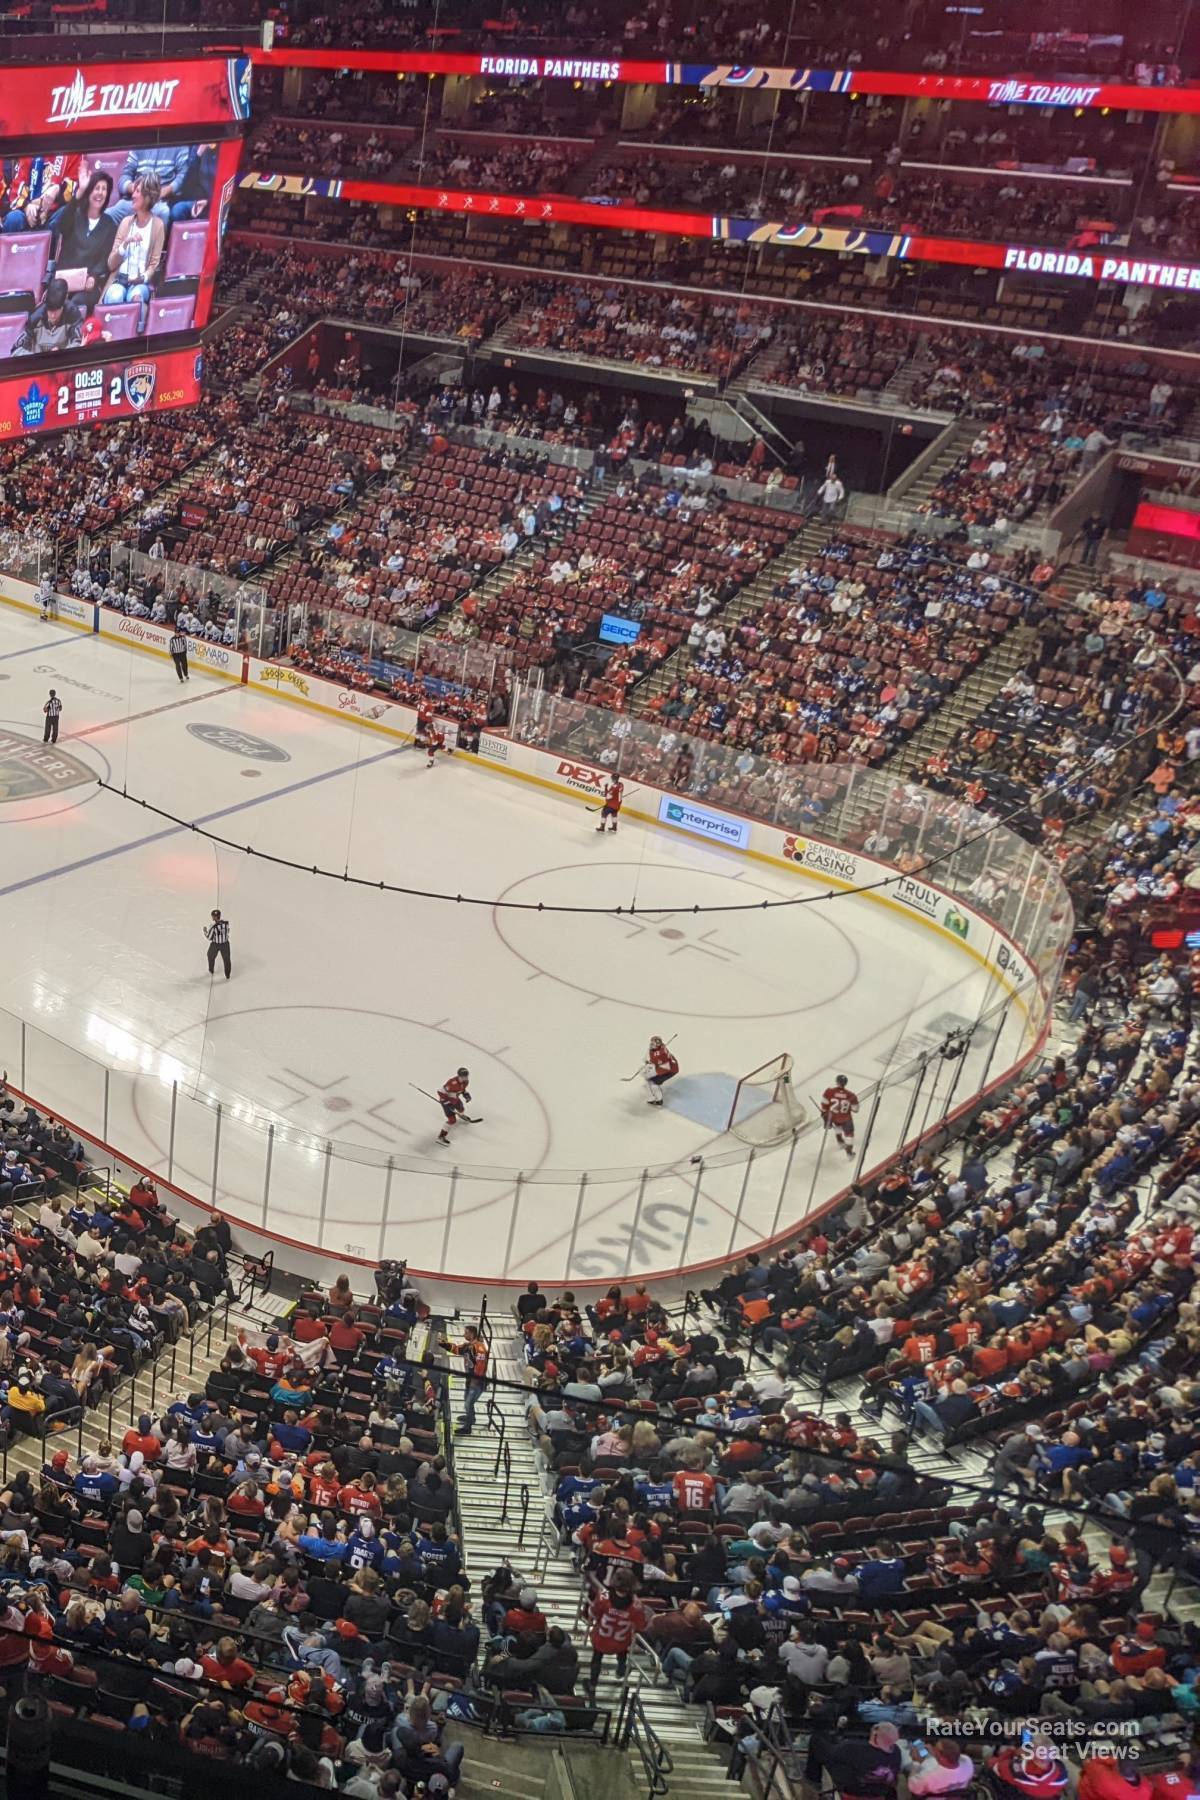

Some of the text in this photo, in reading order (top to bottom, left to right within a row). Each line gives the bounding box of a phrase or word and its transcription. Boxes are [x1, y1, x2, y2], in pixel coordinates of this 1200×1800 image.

[481, 57, 620, 79] FLORIDA PANTHERS
[51, 70, 180, 115] TIME TO HUNT
[988, 80, 1100, 106] TIME TO HUNT
[1004, 249, 1094, 278] FLORIDA
[75, 369, 103, 388] 00:28
[127, 364, 153, 377] FLORIDA
[57, 386, 69, 415] 2
[110, 377, 122, 405] 2
[159, 390, 184, 404] $56,290
[119, 618, 167, 646] Bally SPORTS
[187, 640, 229, 664] BROWARD
[265, 667, 285, 679] GOOD
[338, 692, 357, 709] Stoli
[202, 731, 272, 755] Ford
[557, 762, 606, 788] DEX
[566, 778, 607, 798] imaging
[667, 805, 739, 837] enterprise
[806, 851, 856, 876] CASINO
[808, 842, 858, 867] SEMINOLE
[804, 860, 854, 881] COCONUT CREEK
[897, 877, 942, 907] TRULY
[830, 1098, 850, 1113] 28
[571, 1203, 691, 1277] UKG
[919, 1347, 933, 1362] 16
[315, 1490, 329, 1506] 15
[685, 1488, 704, 1507] 16
[599, 1617, 633, 1642] 52
